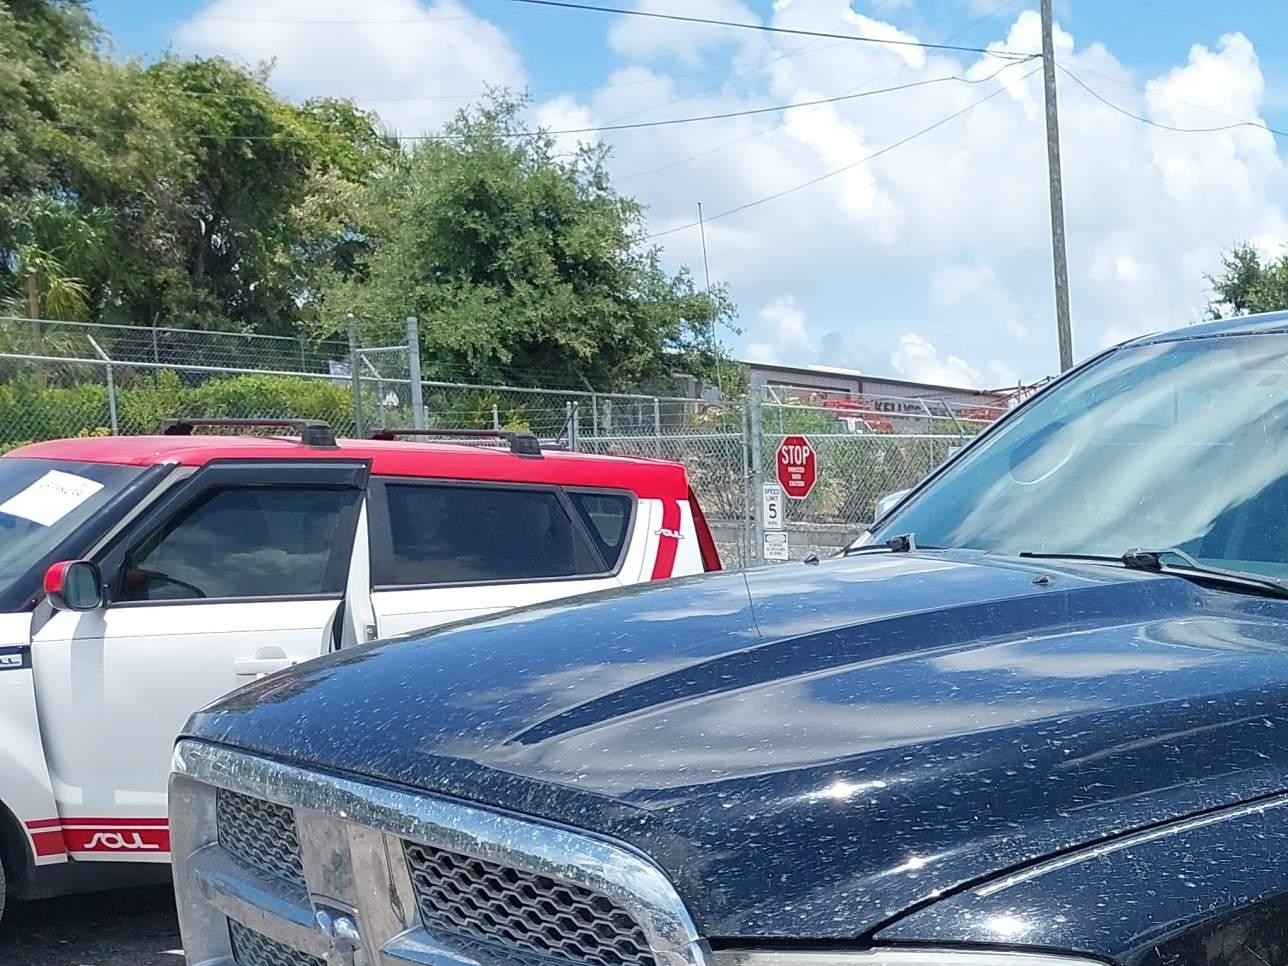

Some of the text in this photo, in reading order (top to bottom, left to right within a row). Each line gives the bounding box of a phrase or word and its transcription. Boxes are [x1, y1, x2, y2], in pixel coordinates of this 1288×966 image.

[781, 445, 810, 465] STOP
[769, 504, 778, 519] 5
[83, 832, 160, 849] SOUL
